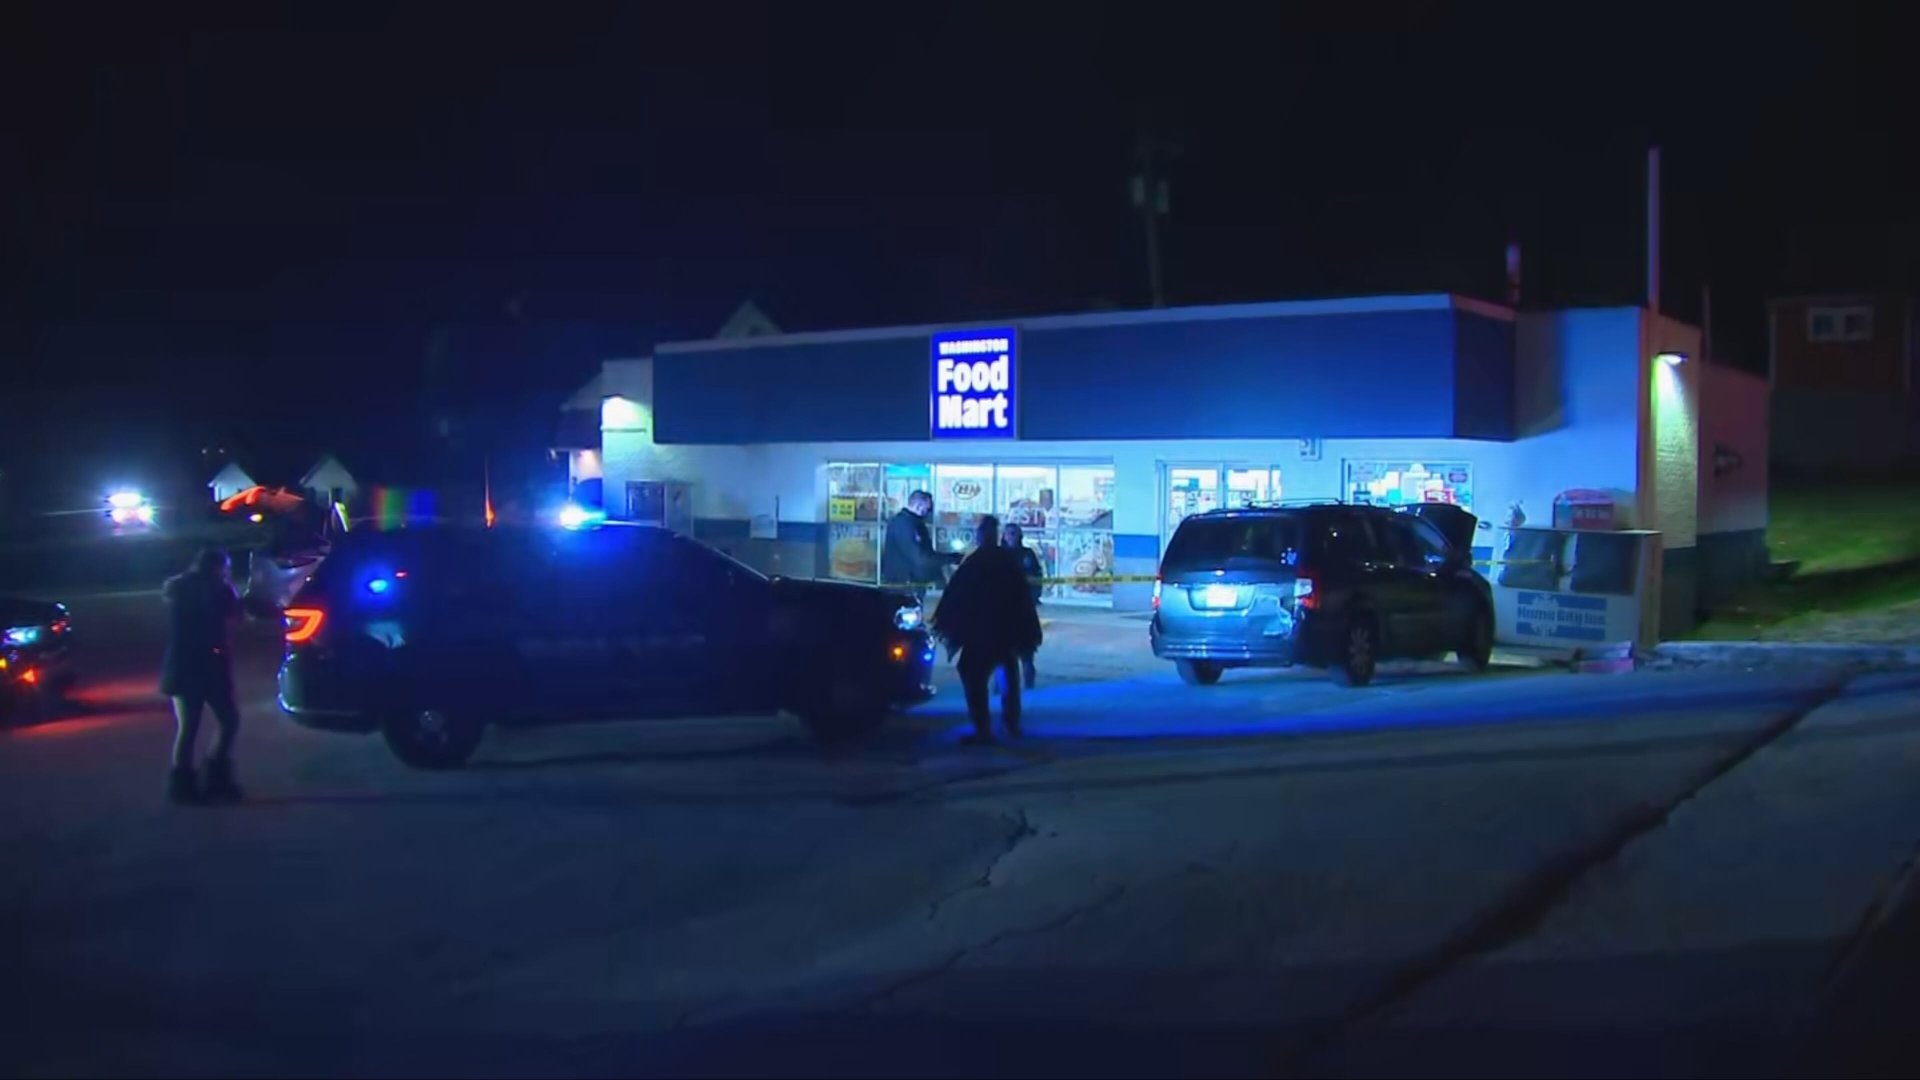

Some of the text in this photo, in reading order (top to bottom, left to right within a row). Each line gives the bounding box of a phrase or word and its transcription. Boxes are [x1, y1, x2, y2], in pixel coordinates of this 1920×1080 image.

[939, 338, 1009, 355] WASHINGTON
[937, 354, 1009, 393] Food
[937, 392, 1009, 429] Mart
[1006, 507, 1054, 525] ASTY
[937, 529, 977, 544] SAVO
[1517, 606, 1607, 627] Home City Ice
